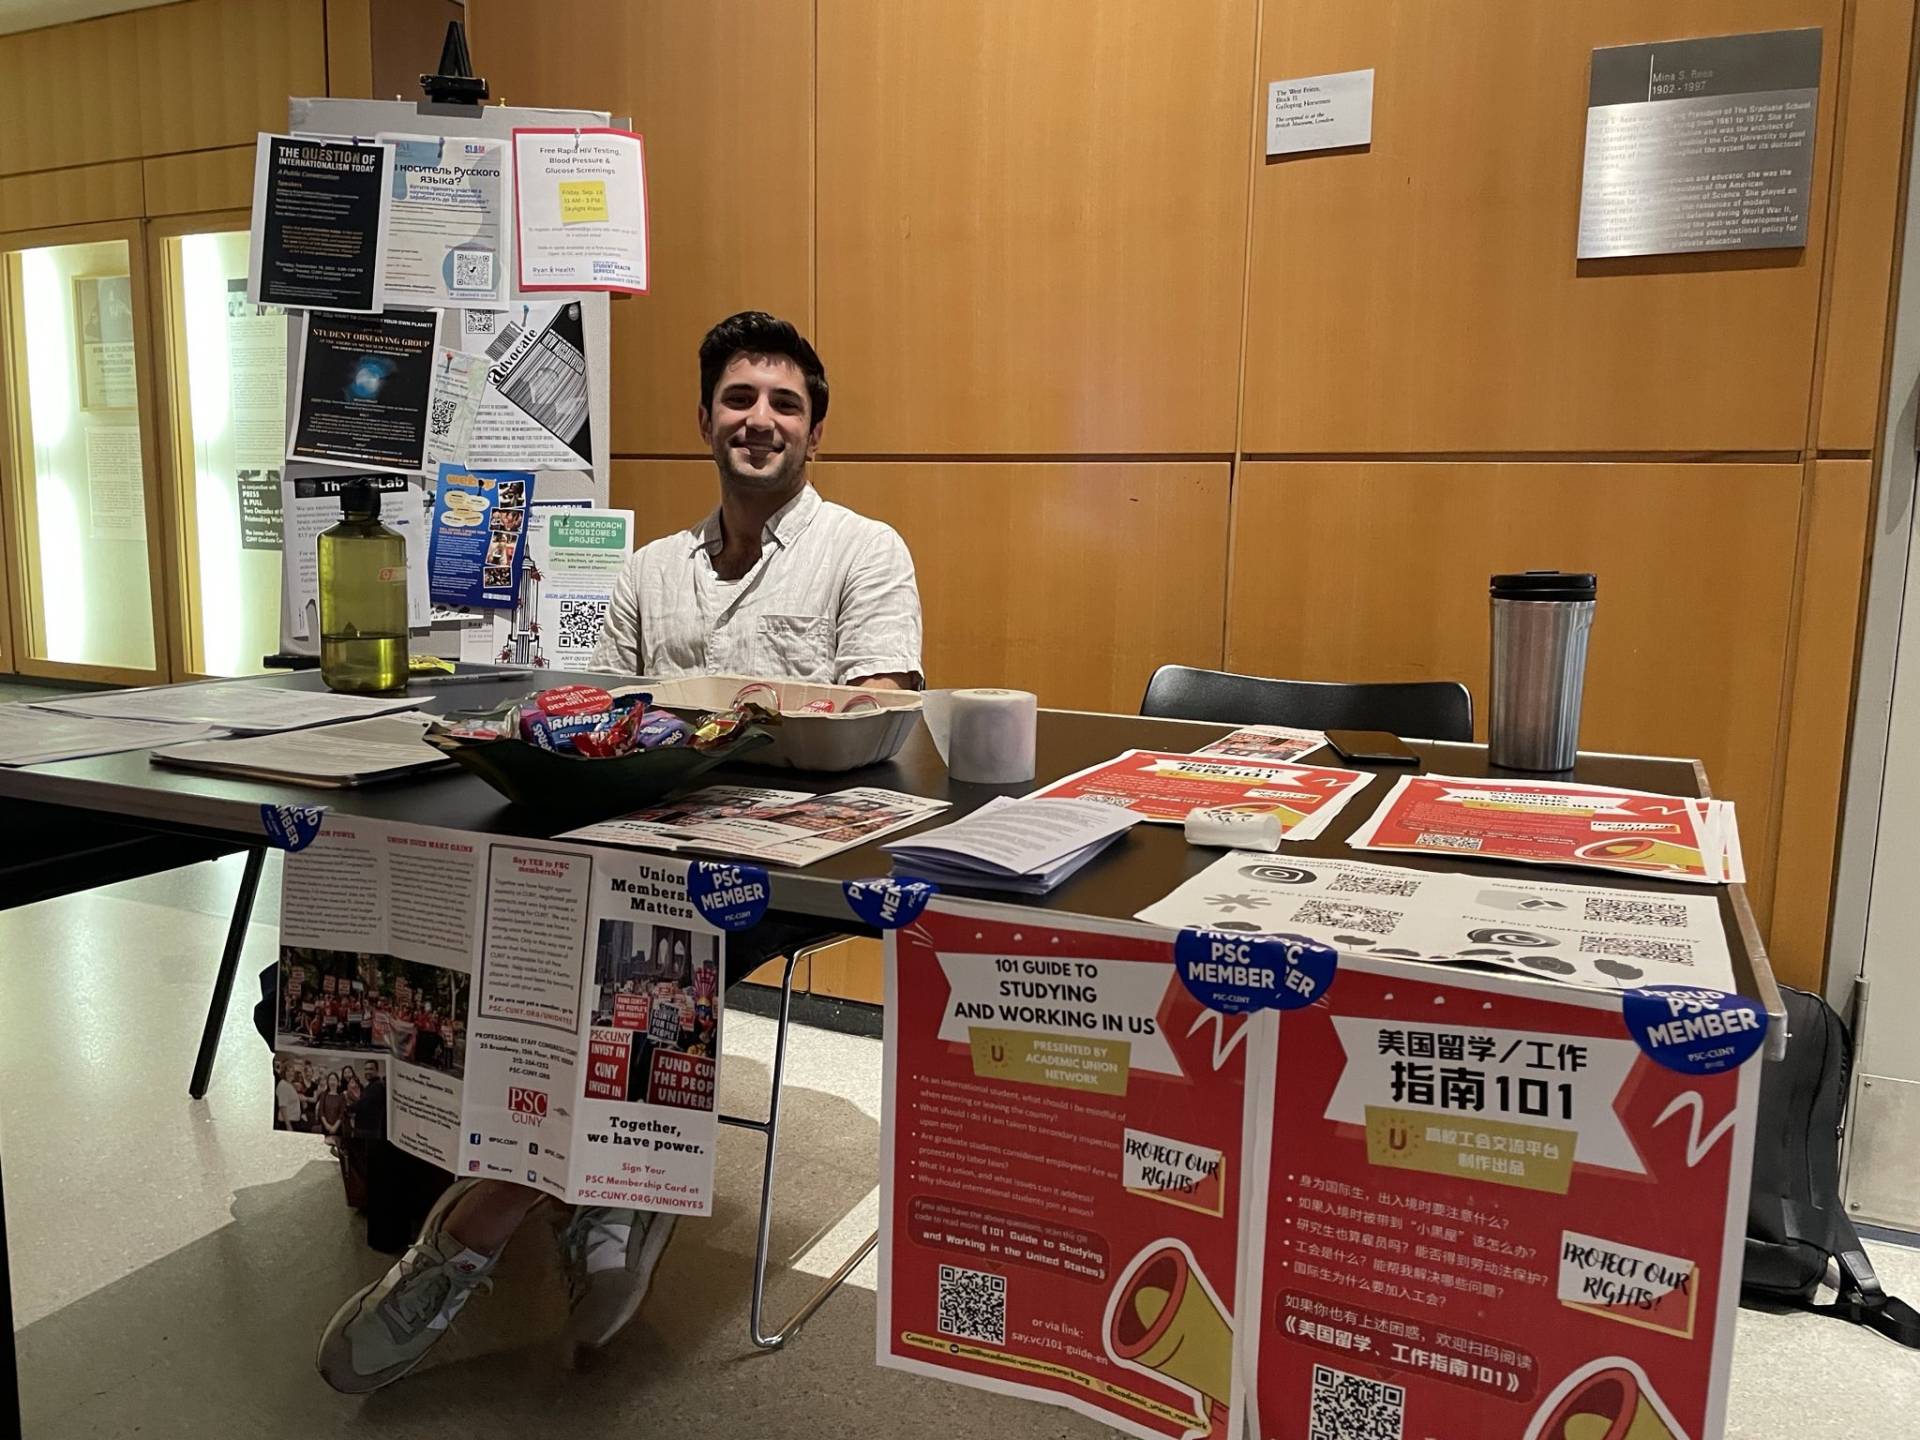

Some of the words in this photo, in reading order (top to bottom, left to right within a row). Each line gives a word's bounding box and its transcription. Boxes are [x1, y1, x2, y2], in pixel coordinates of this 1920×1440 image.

[1652, 71, 1675, 82] Mina
[1652, 84, 1674, 94] 1902
[1276, 102, 1302, 110] Galloping
[278, 158, 350, 171] INTERNATIONALISM
[279, 146, 300, 158] THE
[302, 147, 361, 164] QUESTION
[362, 154, 376, 164] OF
[400, 164, 452, 174] носитель
[454, 166, 500, 178] Русского
[420, 176, 462, 186] языка?
[1742, 207, 1764, 215] World
[1766, 206, 1781, 214] War
[313, 328, 350, 340] STUDENT
[353, 334, 400, 345] OBSERVING
[402, 338, 430, 348] GROUP
[487, 328, 538, 386] advocate
[243, 490, 260, 498] PRESS
[558, 528, 617, 537] MICROBIOMES
[574, 520, 622, 530] COCKROACH
[569, 536, 606, 544] PROJECT
[545, 688, 598, 702] EDUCATION
[547, 694, 610, 710] DEPORTATION
[512, 856, 527, 866] Say
[530, 858, 543, 866] YES
[554, 862, 570, 870] PSC
[518, 866, 564, 878] membership
[640, 866, 686, 886] Union
[712, 868, 742, 890] PSC
[701, 883, 764, 911] MEMBER
[631, 897, 693, 918] Matters
[1212, 942, 1250, 964] PSC
[995, 958, 1019, 973] 101
[1022, 960, 1071, 976] GUIDE
[1074, 963, 1098, 979] TO
[1188, 962, 1275, 990] MEMBER
[1000, 980, 1098, 1004] STUDYING
[1666, 998, 1720, 1017] PSC
[954, 1002, 994, 1020] AND
[1000, 1005, 1098, 1030] WORKING
[1102, 1013, 1124, 1032] IN
[1128, 1015, 1156, 1036] US
[1647, 1008, 1760, 1048] MEMBER
[590, 1030, 631, 1043] PSC-CUNY
[591, 1042, 614, 1057] INVEST
[616, 1046, 626, 1058] IN
[1032, 1040, 1091, 1056] PRESENTED
[1093, 1045, 1108, 1057] BY
[1688, 1046, 1735, 1062] PSC-CUNY
[594, 1062, 619, 1080] CUNY
[658, 1056, 691, 1073] FUND
[1025, 1052, 1079, 1070] ACADEMIC
[1081, 1059, 1118, 1074] UNION
[654, 1070, 677, 1087] THE
[1044, 1068, 1098, 1085] NETWORK
[612, 1086, 622, 1098] IN
[1390, 1060, 1572, 1120] 指南101
[511, 1088, 546, 1116] PSC
[512, 1112, 543, 1128] CUNY
[610, 1116, 681, 1137] Together,
[587, 1133, 609, 1143] we
[612, 1132, 650, 1148] have
[654, 1140, 704, 1155] power.
[1426, 1126, 1560, 1160] 高校工会交流平台
[622, 1162, 642, 1174] Sign
[644, 1165, 666, 1176] Your
[1126, 1138, 1184, 1167] PROTECT
[1185, 1154, 1219, 1181] OUR
[1457, 1152, 1526, 1176] 制作出品
[586, 1174, 604, 1184] PSC
[606, 1176, 662, 1191] Membership
[664, 1182, 687, 1193] Card
[1142, 1166, 1200, 1194] RIGHTS!
[578, 1189, 704, 1209] PSC-CUNY.ORG/UNIONYES
[923, 1231, 942, 1241] and
[946, 1234, 986, 1252] Working
[990, 1242, 1000, 1252] in
[1004, 1246, 1021, 1257] the
[1026, 1250, 1060, 1266] United
[1010, 1230, 1038, 1245] Guide
[1044, 1240, 1054, 1248] to
[1059, 1242, 1103, 1264] Studying
[1564, 1242, 1643, 1278] PROTECT
[1644, 1262, 1690, 1296] OUR
[1583, 1276, 1662, 1311] RIGHTS!
[1032, 1318, 1043, 1327] or
[1046, 1319, 1061, 1330] via
[1062, 1322, 1084, 1338] link:
[906, 1333, 934, 1348] Contact
[1011, 1330, 1109, 1366] say.vc/101-guide-en
